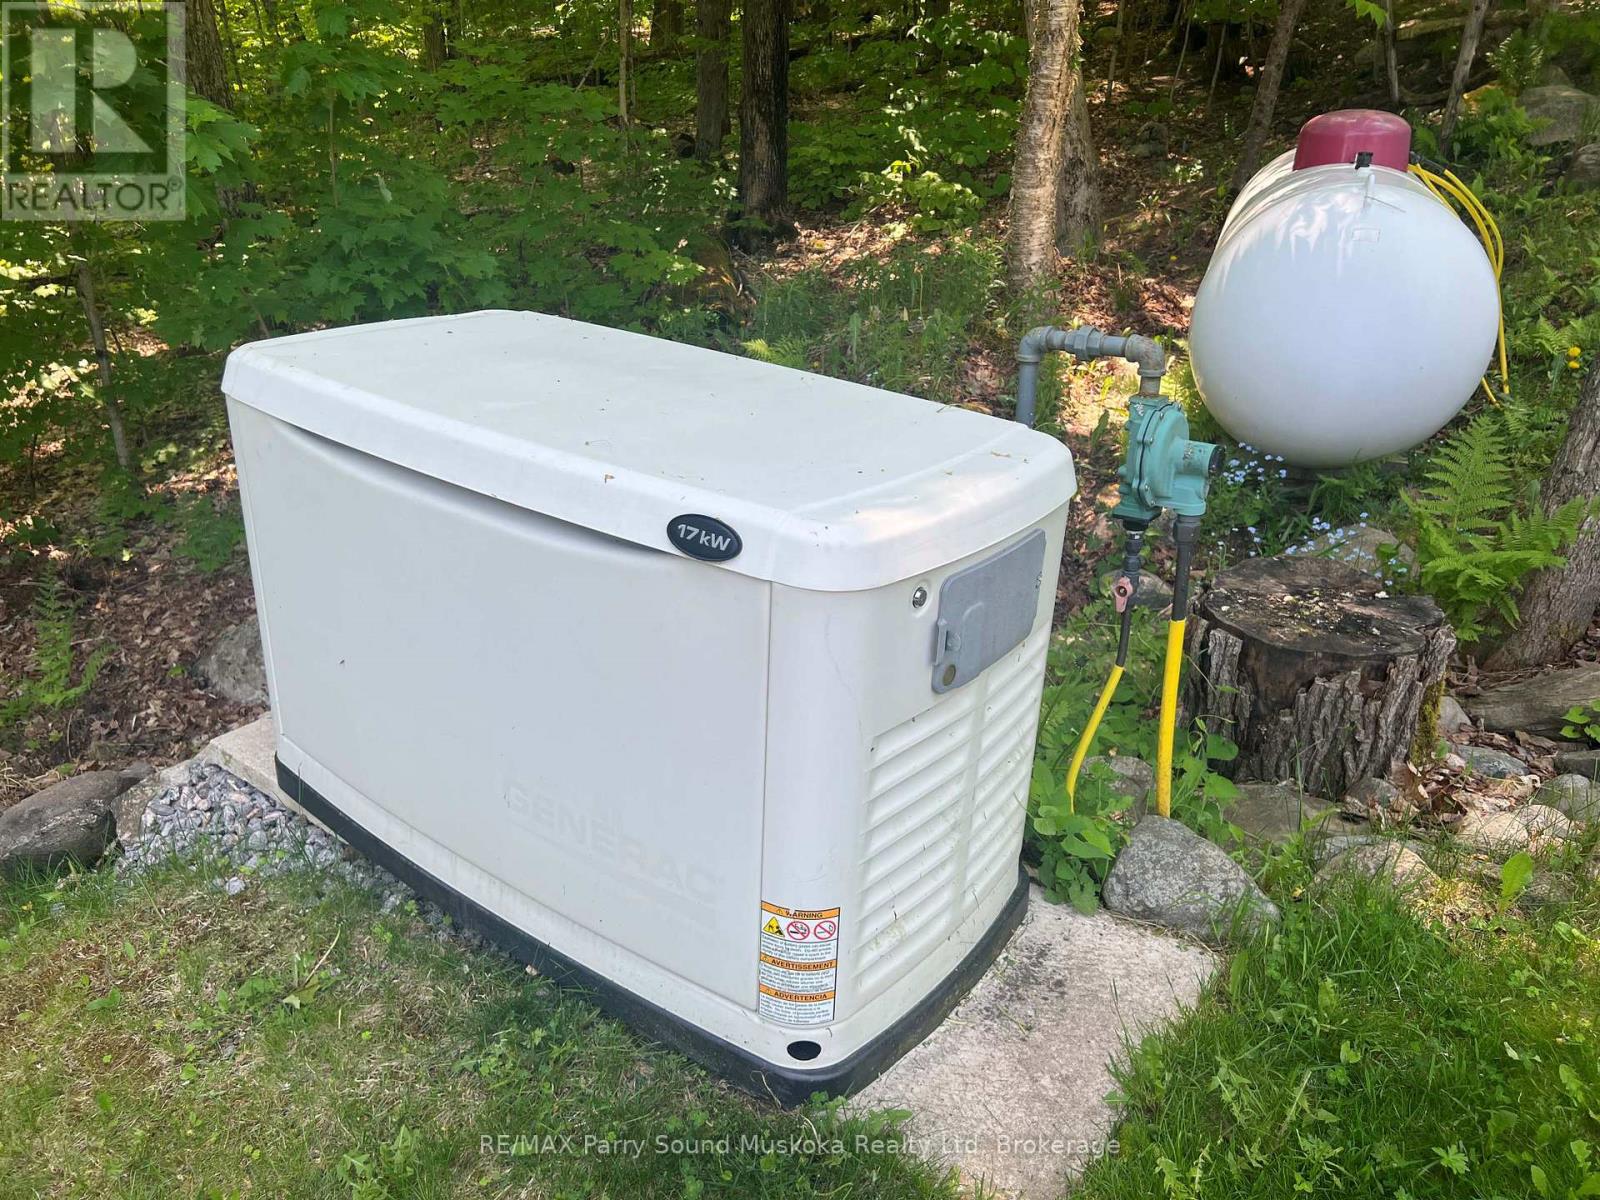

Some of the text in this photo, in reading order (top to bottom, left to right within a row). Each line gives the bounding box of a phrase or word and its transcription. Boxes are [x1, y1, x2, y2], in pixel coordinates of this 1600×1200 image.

[505, 780, 720, 902] GENERAC
[771, 959, 834, 971] AVERTISSEMENT
[774, 991, 827, 1002] ADVERTENCIA
